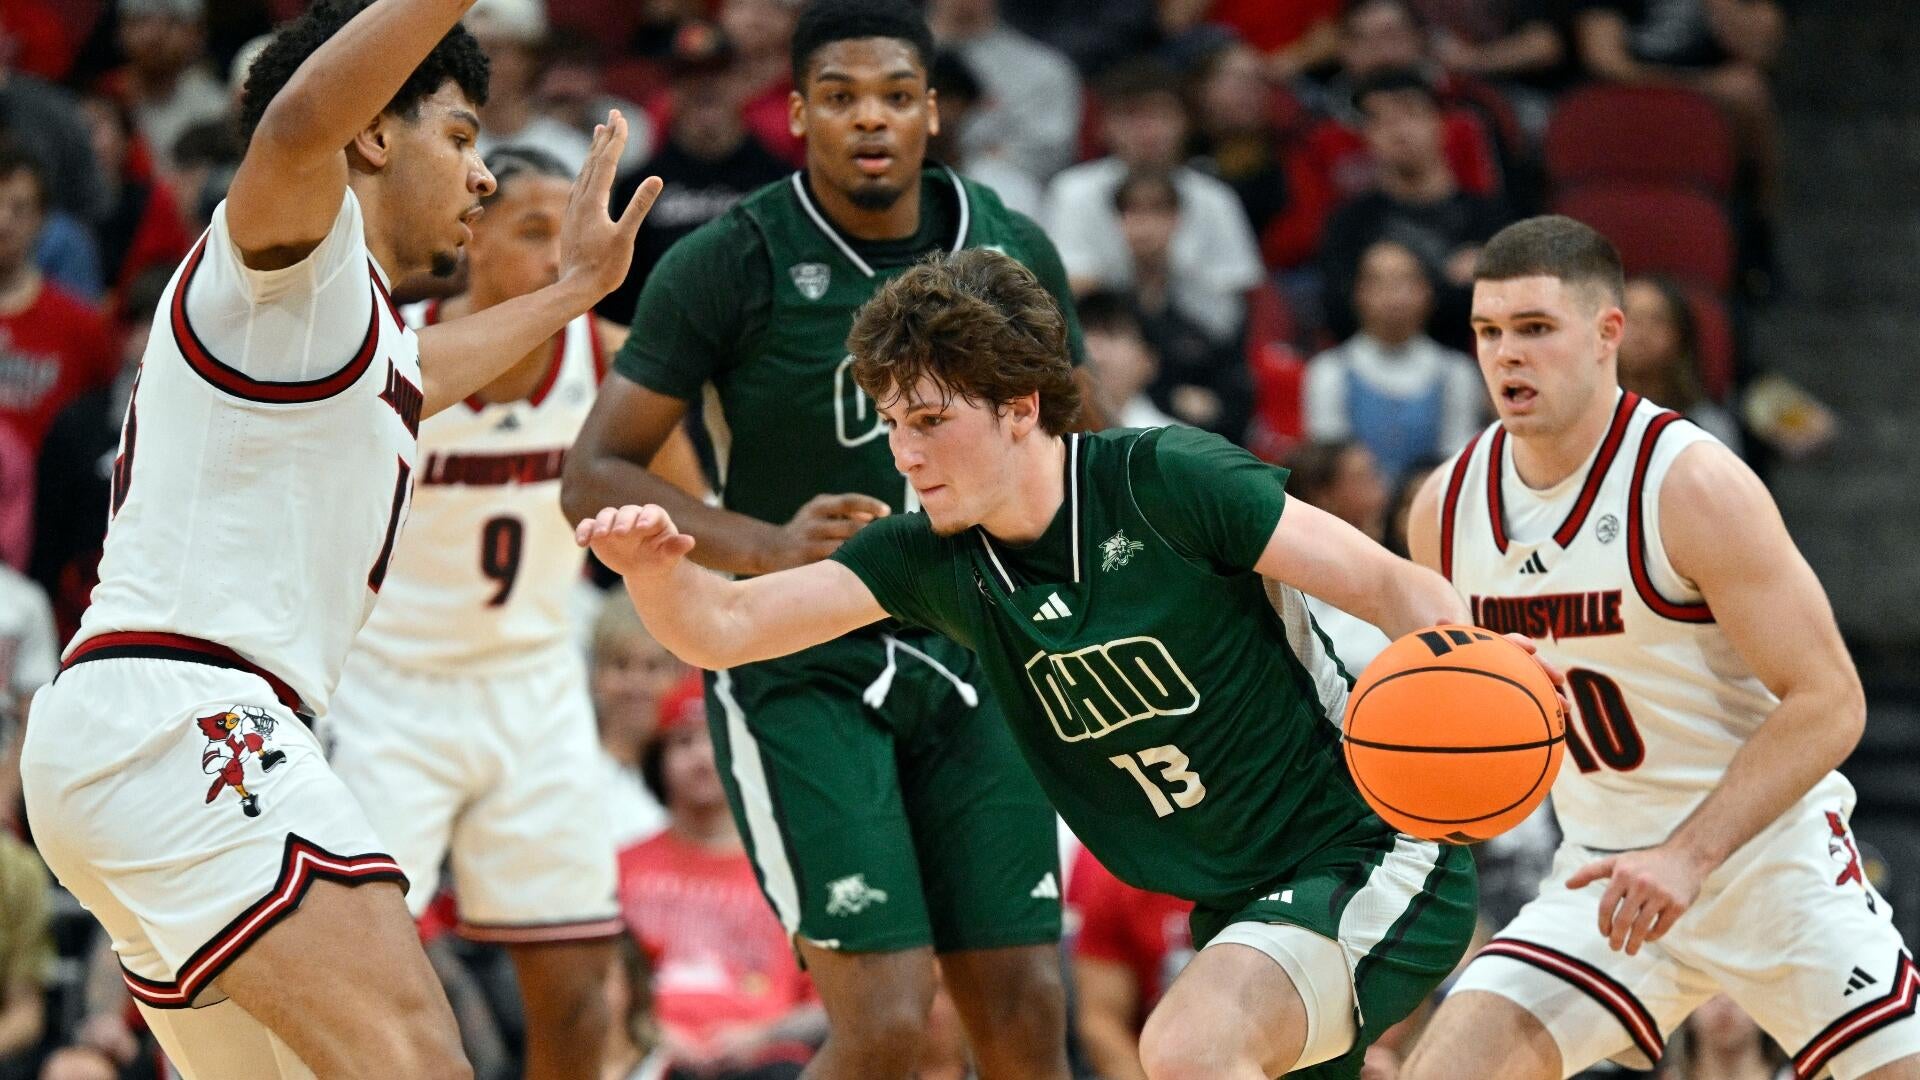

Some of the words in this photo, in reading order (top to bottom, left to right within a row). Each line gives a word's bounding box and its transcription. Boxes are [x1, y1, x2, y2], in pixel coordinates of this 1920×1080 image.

[481, 516, 524, 607] 9
[1470, 589, 1625, 645] LOUISVILLE
[1025, 636, 1200, 742] OHIO
[1556, 667, 1646, 774] 10
[1108, 744, 1206, 818] 13
